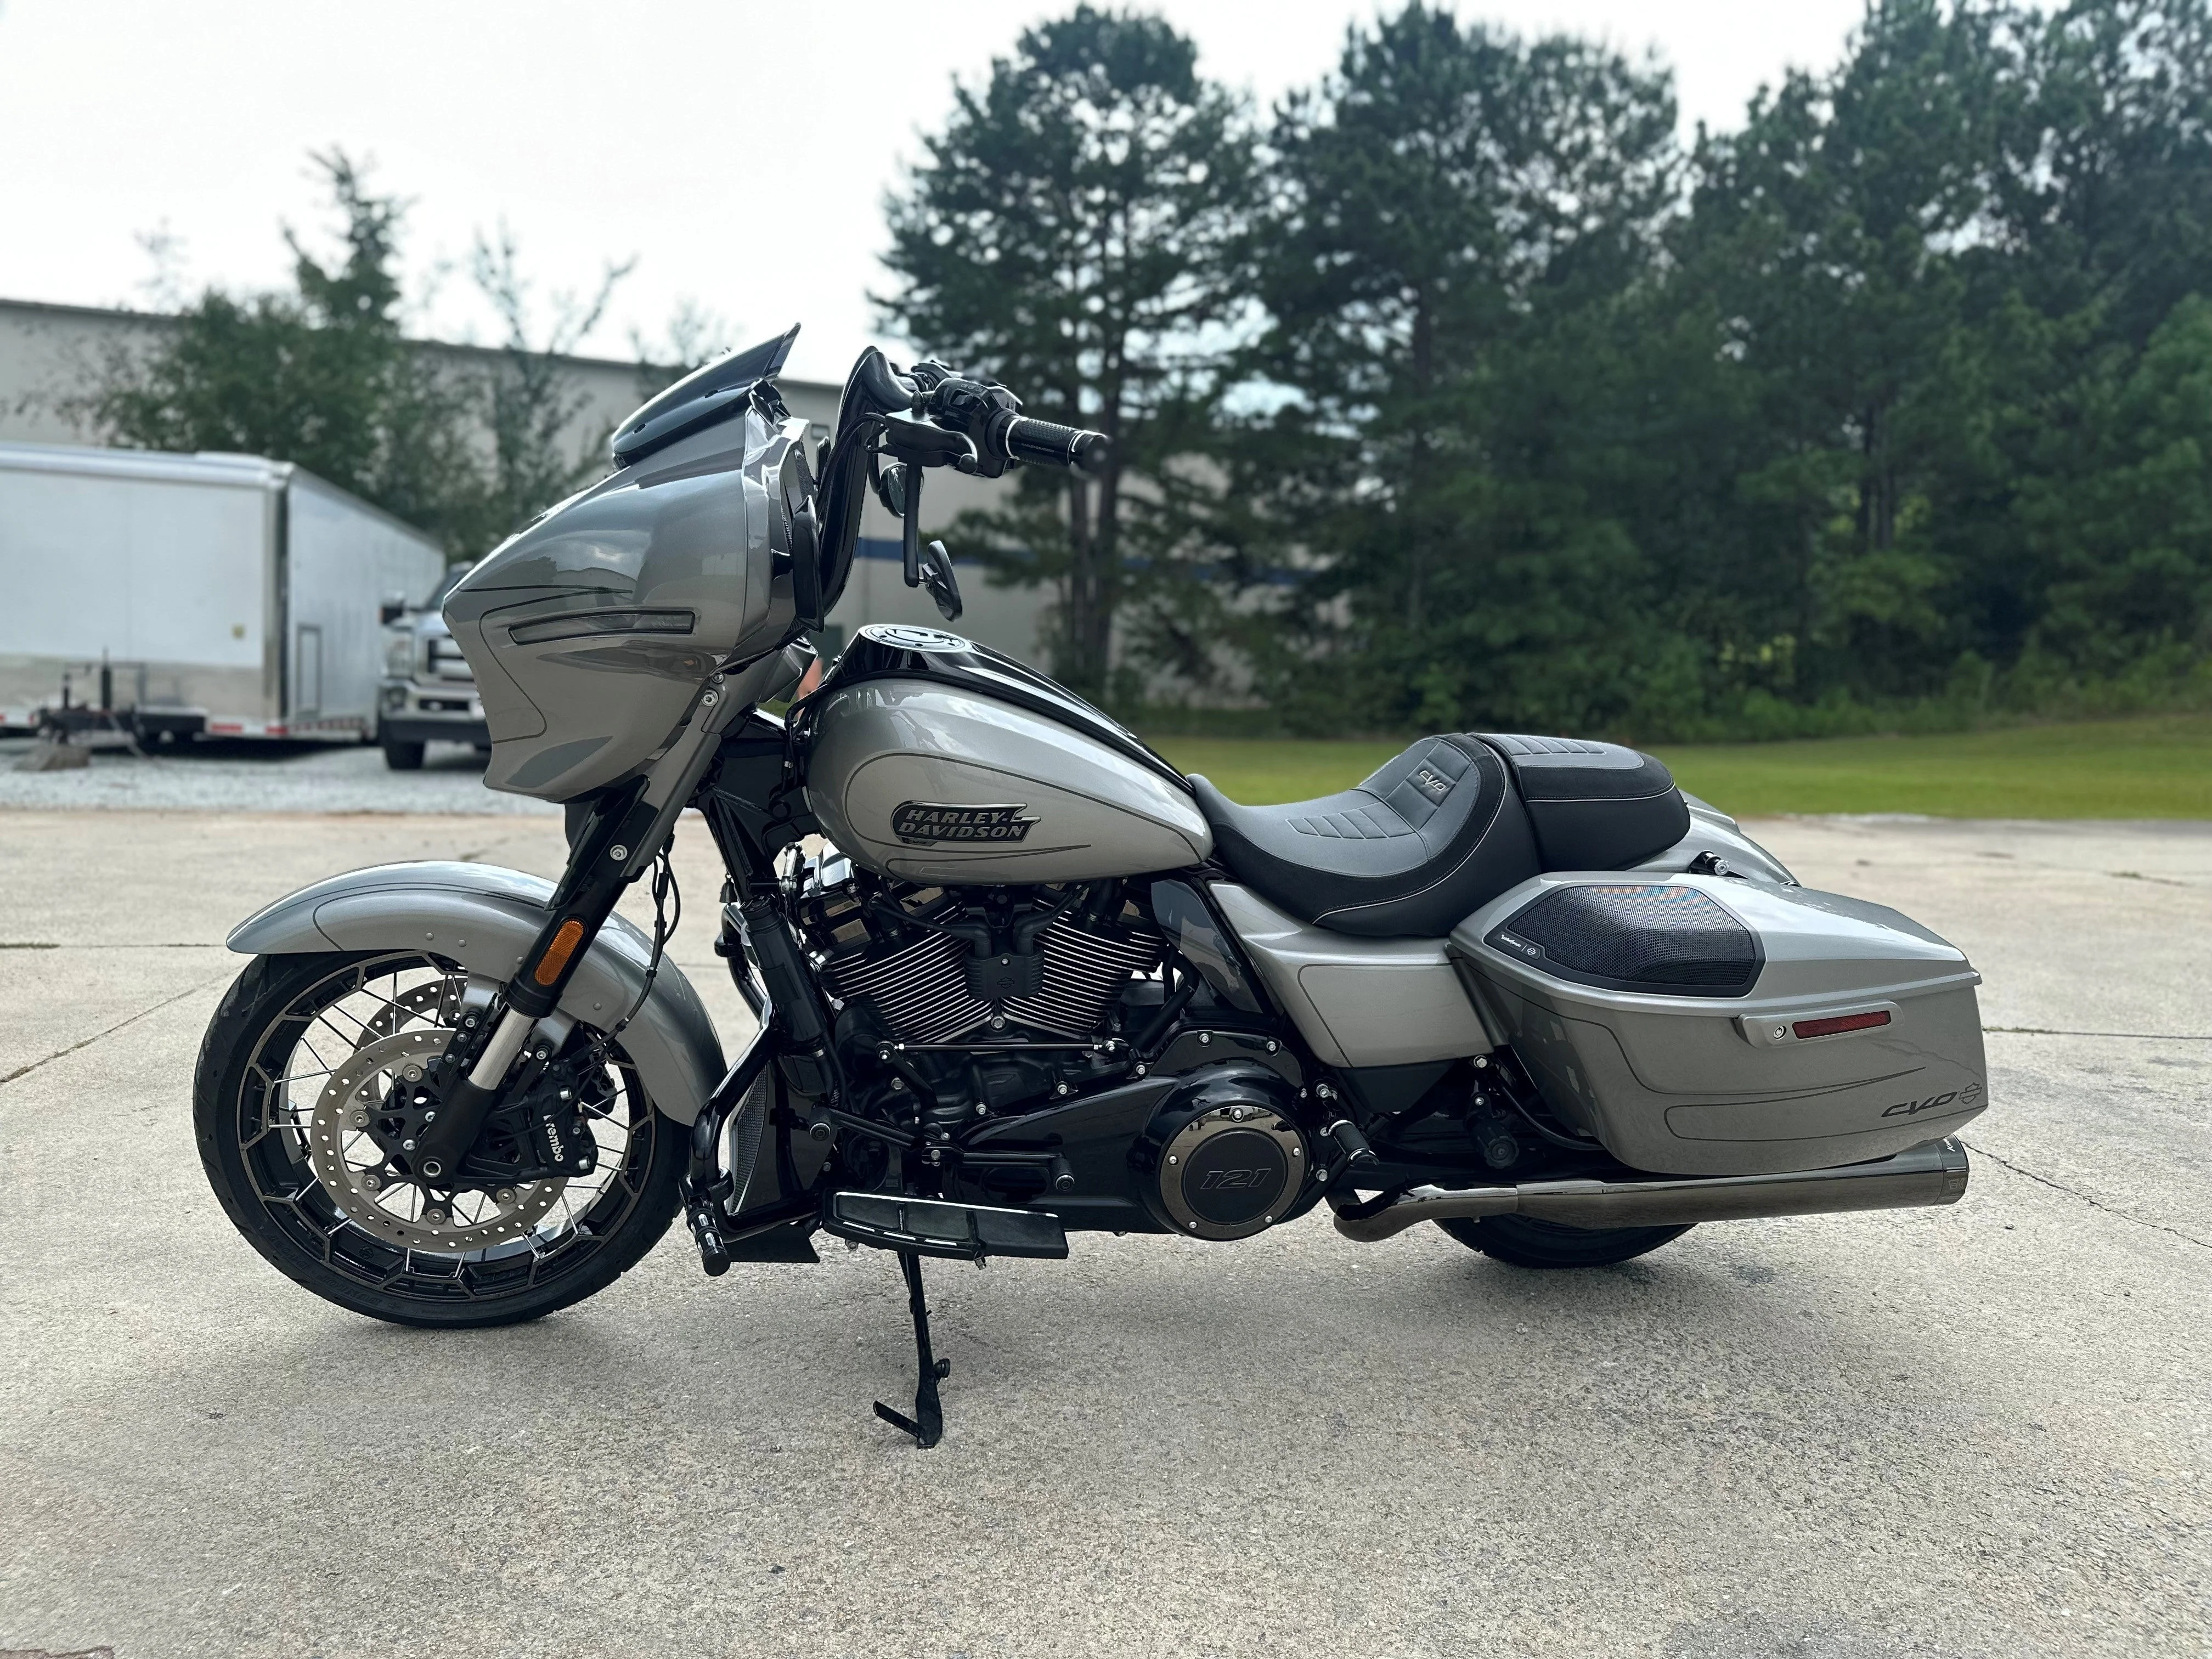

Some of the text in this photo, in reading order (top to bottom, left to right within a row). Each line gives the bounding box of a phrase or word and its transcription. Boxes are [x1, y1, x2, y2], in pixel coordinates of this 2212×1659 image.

[1419, 770, 1447, 792] CVO
[906, 809, 1008, 824] HARLEY-
[898, 822, 1025, 838] DAVIDSON
[1881, 1091, 1958, 1118] CVO
[1200, 1168, 1272, 1190] 121
